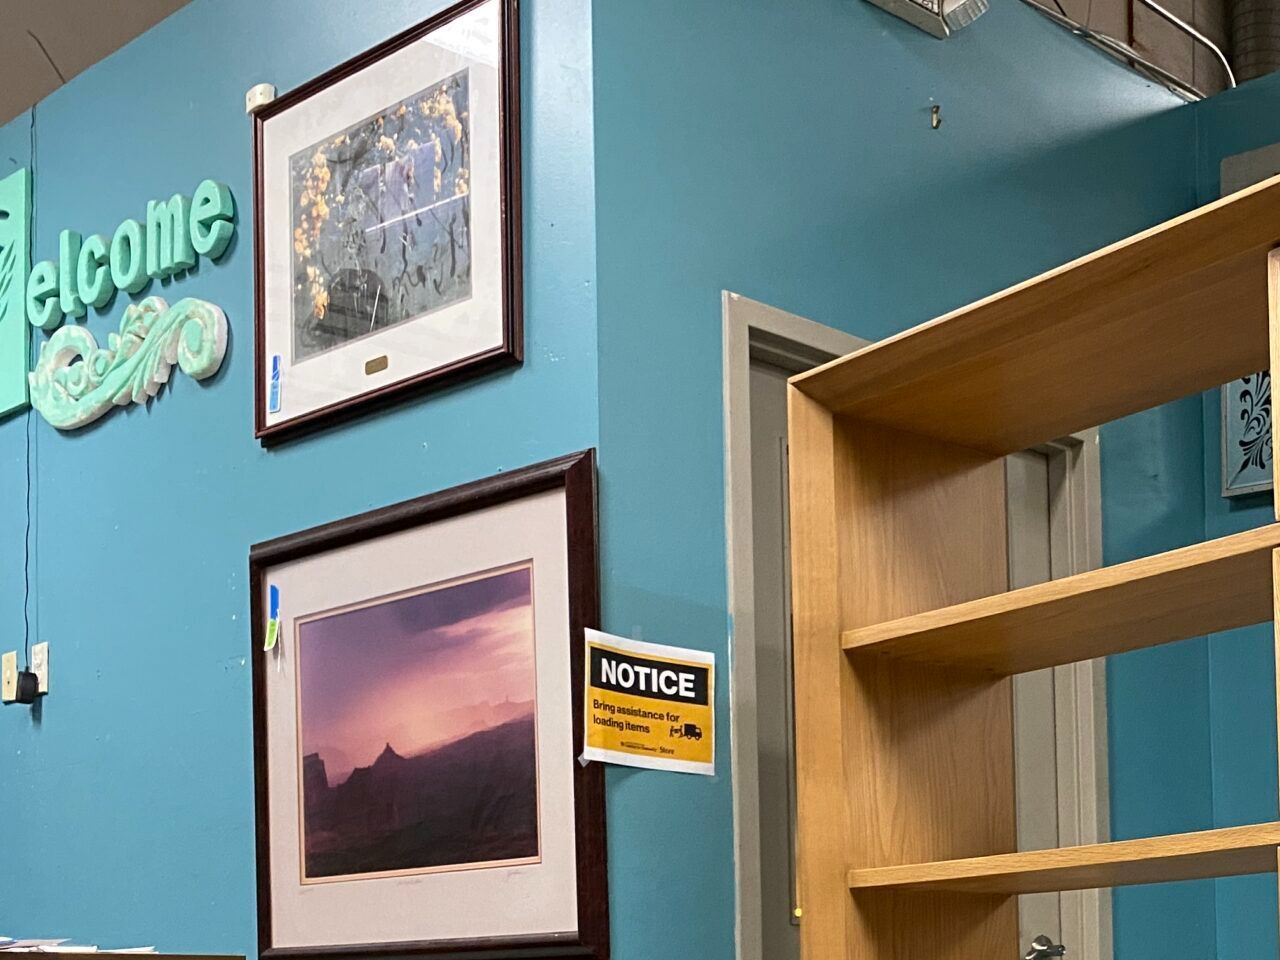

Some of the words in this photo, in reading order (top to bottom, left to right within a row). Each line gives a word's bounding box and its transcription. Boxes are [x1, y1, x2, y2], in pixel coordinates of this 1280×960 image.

[601, 658, 696, 698] NOTICE
[593, 699, 616, 714] Bring
[616, 706, 665, 721] assistance
[666, 712, 680, 722] for
[593, 715, 624, 731] loading
[625, 721, 650, 733] items
